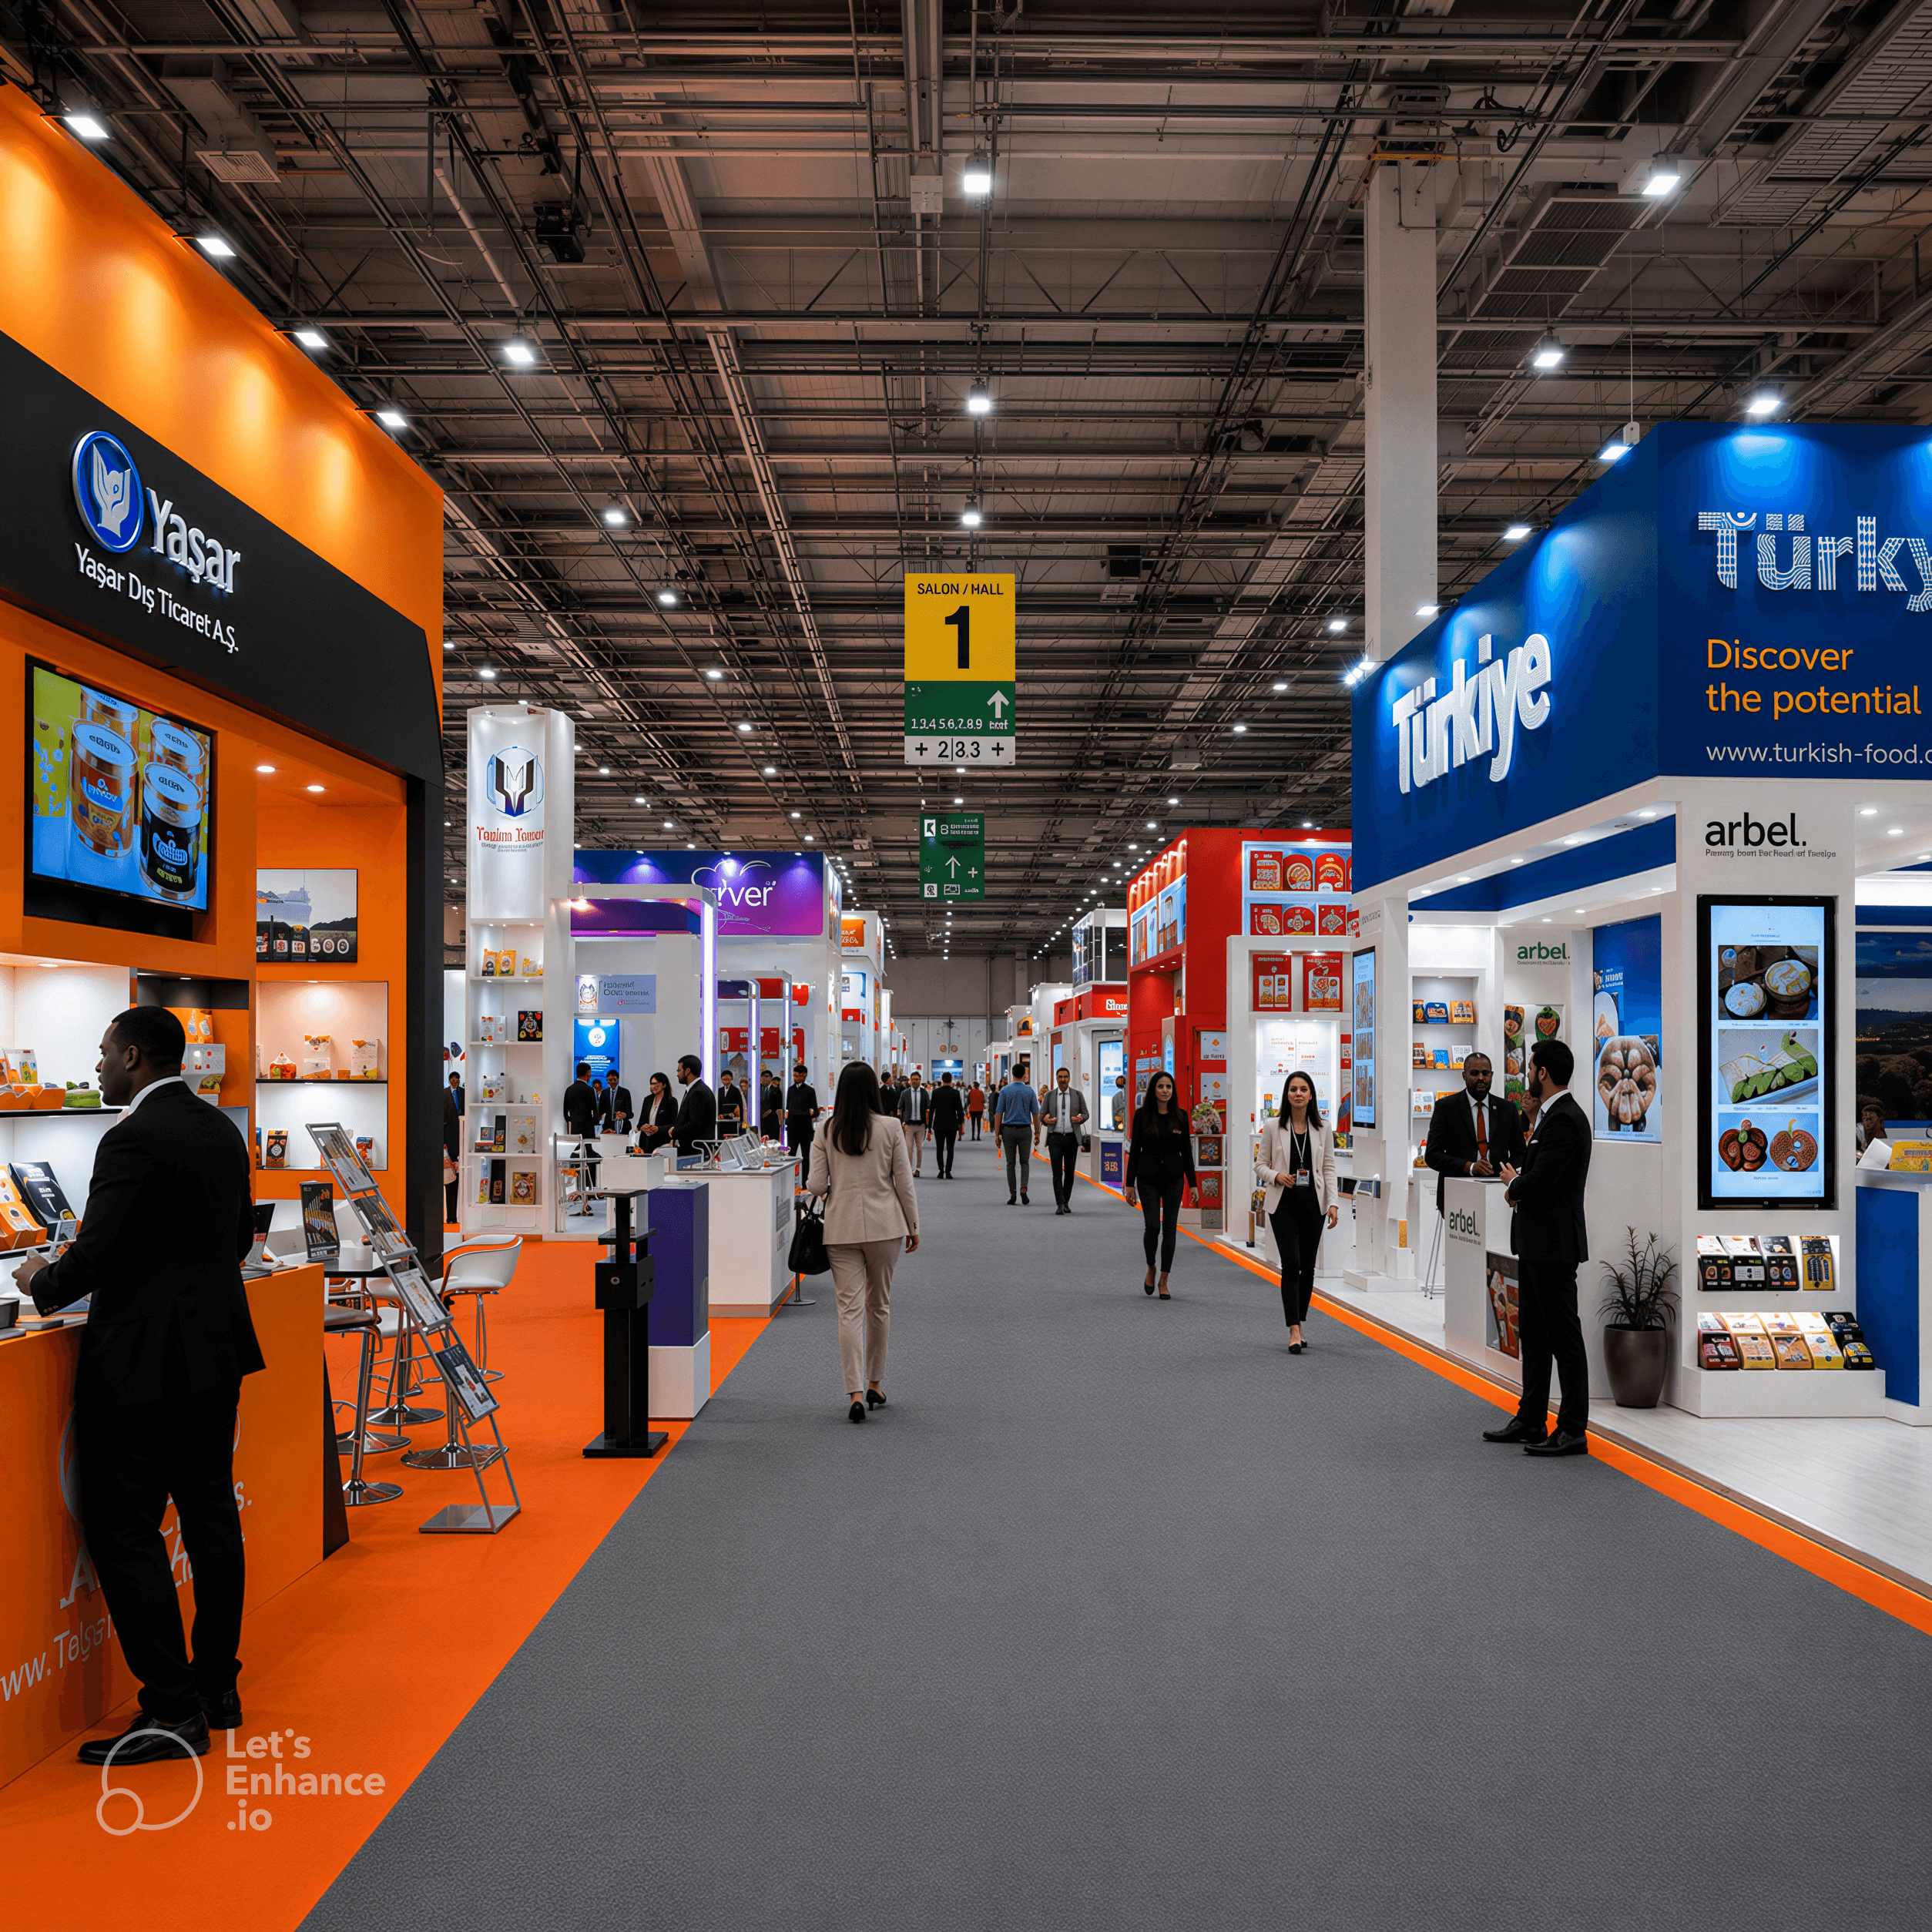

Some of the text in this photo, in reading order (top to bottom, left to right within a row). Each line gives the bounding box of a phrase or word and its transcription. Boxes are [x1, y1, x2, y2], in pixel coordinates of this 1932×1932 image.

[146, 487, 241, 593] Yaşar
[75, 542, 126, 592] Yaşar
[128, 572, 155, 614] Dış
[156, 587, 210, 638] Ticaret
[917, 583, 960, 595] SALON
[971, 583, 1005, 595] HALL
[944, 605, 970, 669] 1
[1707, 639, 1854, 671] Discover
[1392, 633, 1551, 795] Türkiye
[1706, 683, 1922, 720] the potential
[1705, 811, 1807, 847] arbel.
[1517, 941, 1571, 960] arbel.
